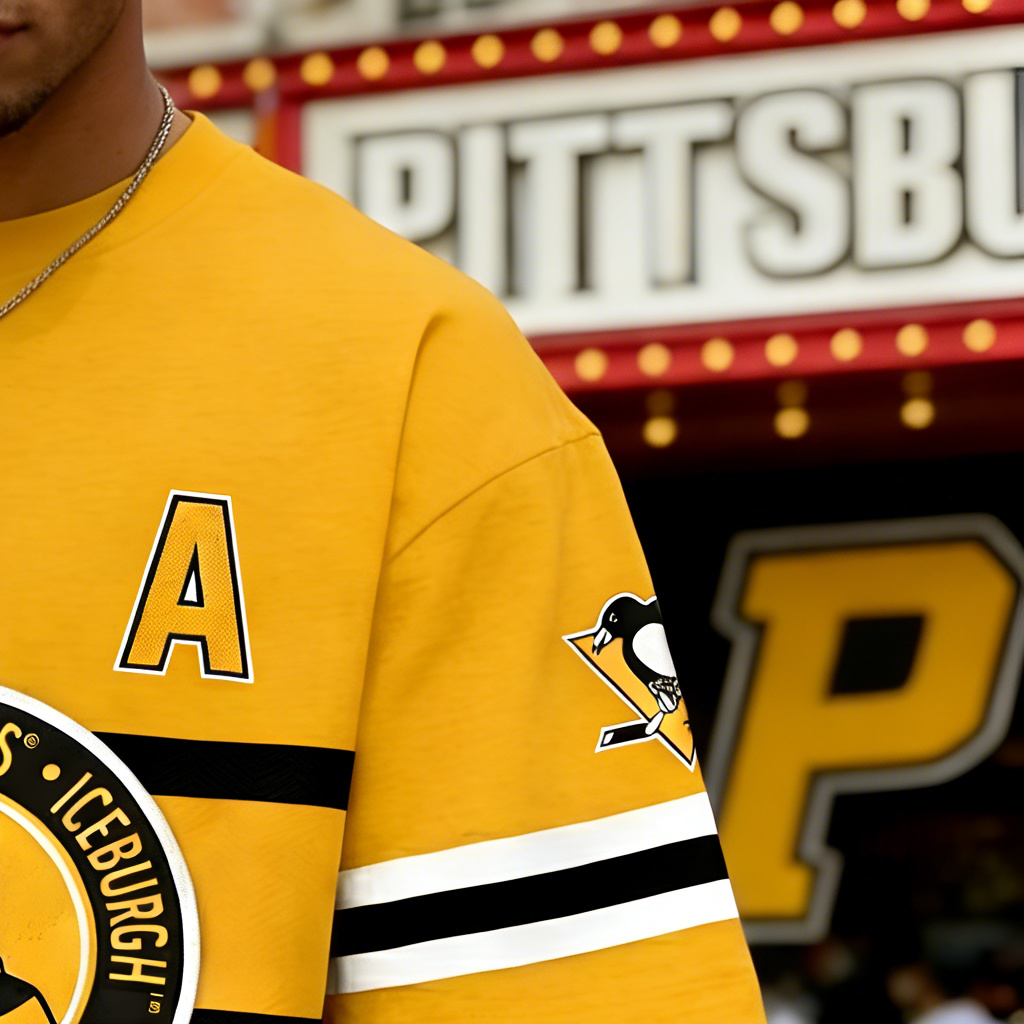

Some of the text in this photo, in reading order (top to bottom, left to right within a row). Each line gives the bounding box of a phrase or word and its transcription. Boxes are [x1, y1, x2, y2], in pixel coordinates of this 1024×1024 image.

[113, 489, 255, 684] A
[701, 513, 1024, 944] P
[49, 771, 169, 986] ICEBURGH
